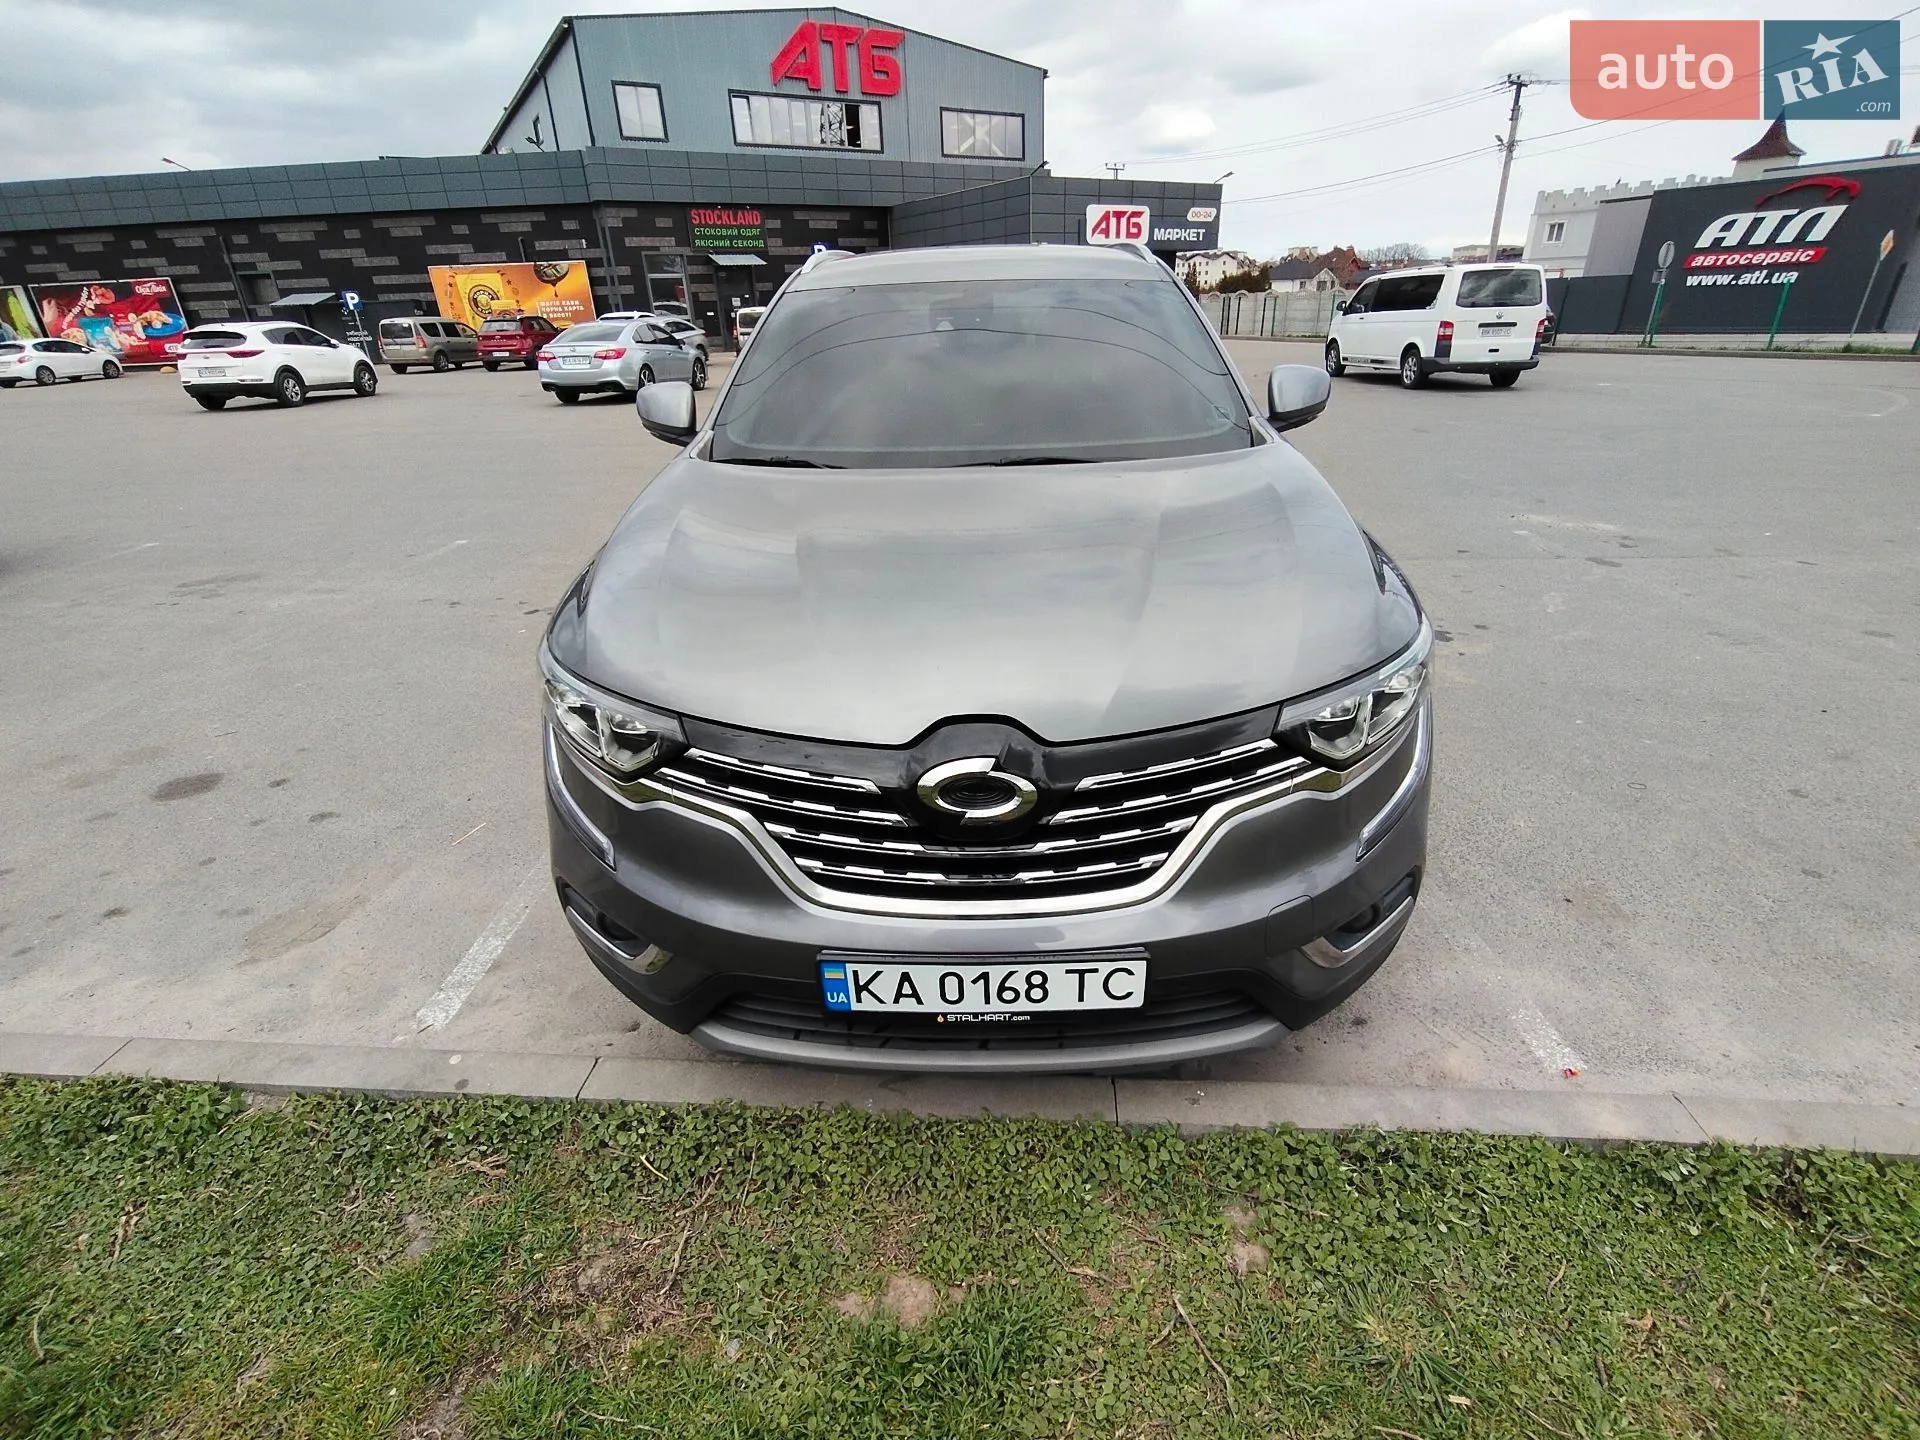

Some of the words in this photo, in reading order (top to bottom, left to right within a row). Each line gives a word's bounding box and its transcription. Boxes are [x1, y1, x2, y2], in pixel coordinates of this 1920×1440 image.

[771, 20, 905, 96] АТБ
[691, 209, 761, 226] STOCKLAND
[1091, 210, 1145, 240] АТБ
[694, 227, 739, 237] СТОКОВИЙ
[740, 228, 761, 238] ОДЯГ
[1153, 228, 1206, 241] МАРКЕТ
[1694, 205, 1849, 249] АТЛ
[695, 238, 731, 248] ЯКІСНИЙ
[732, 239, 765, 249] СЕКОНД
[1690, 249, 1815, 267] автосервіс
[1686, 269, 1799, 287] www.atl.ua
[345, 292, 359, 310] P
[852, 969, 925, 1006] KA
[938, 969, 1049, 1006] 0168
[1065, 966, 1137, 1004] TC
[826, 991, 848, 1004] UA
[947, 1013, 1031, 1024] STALHART.com
